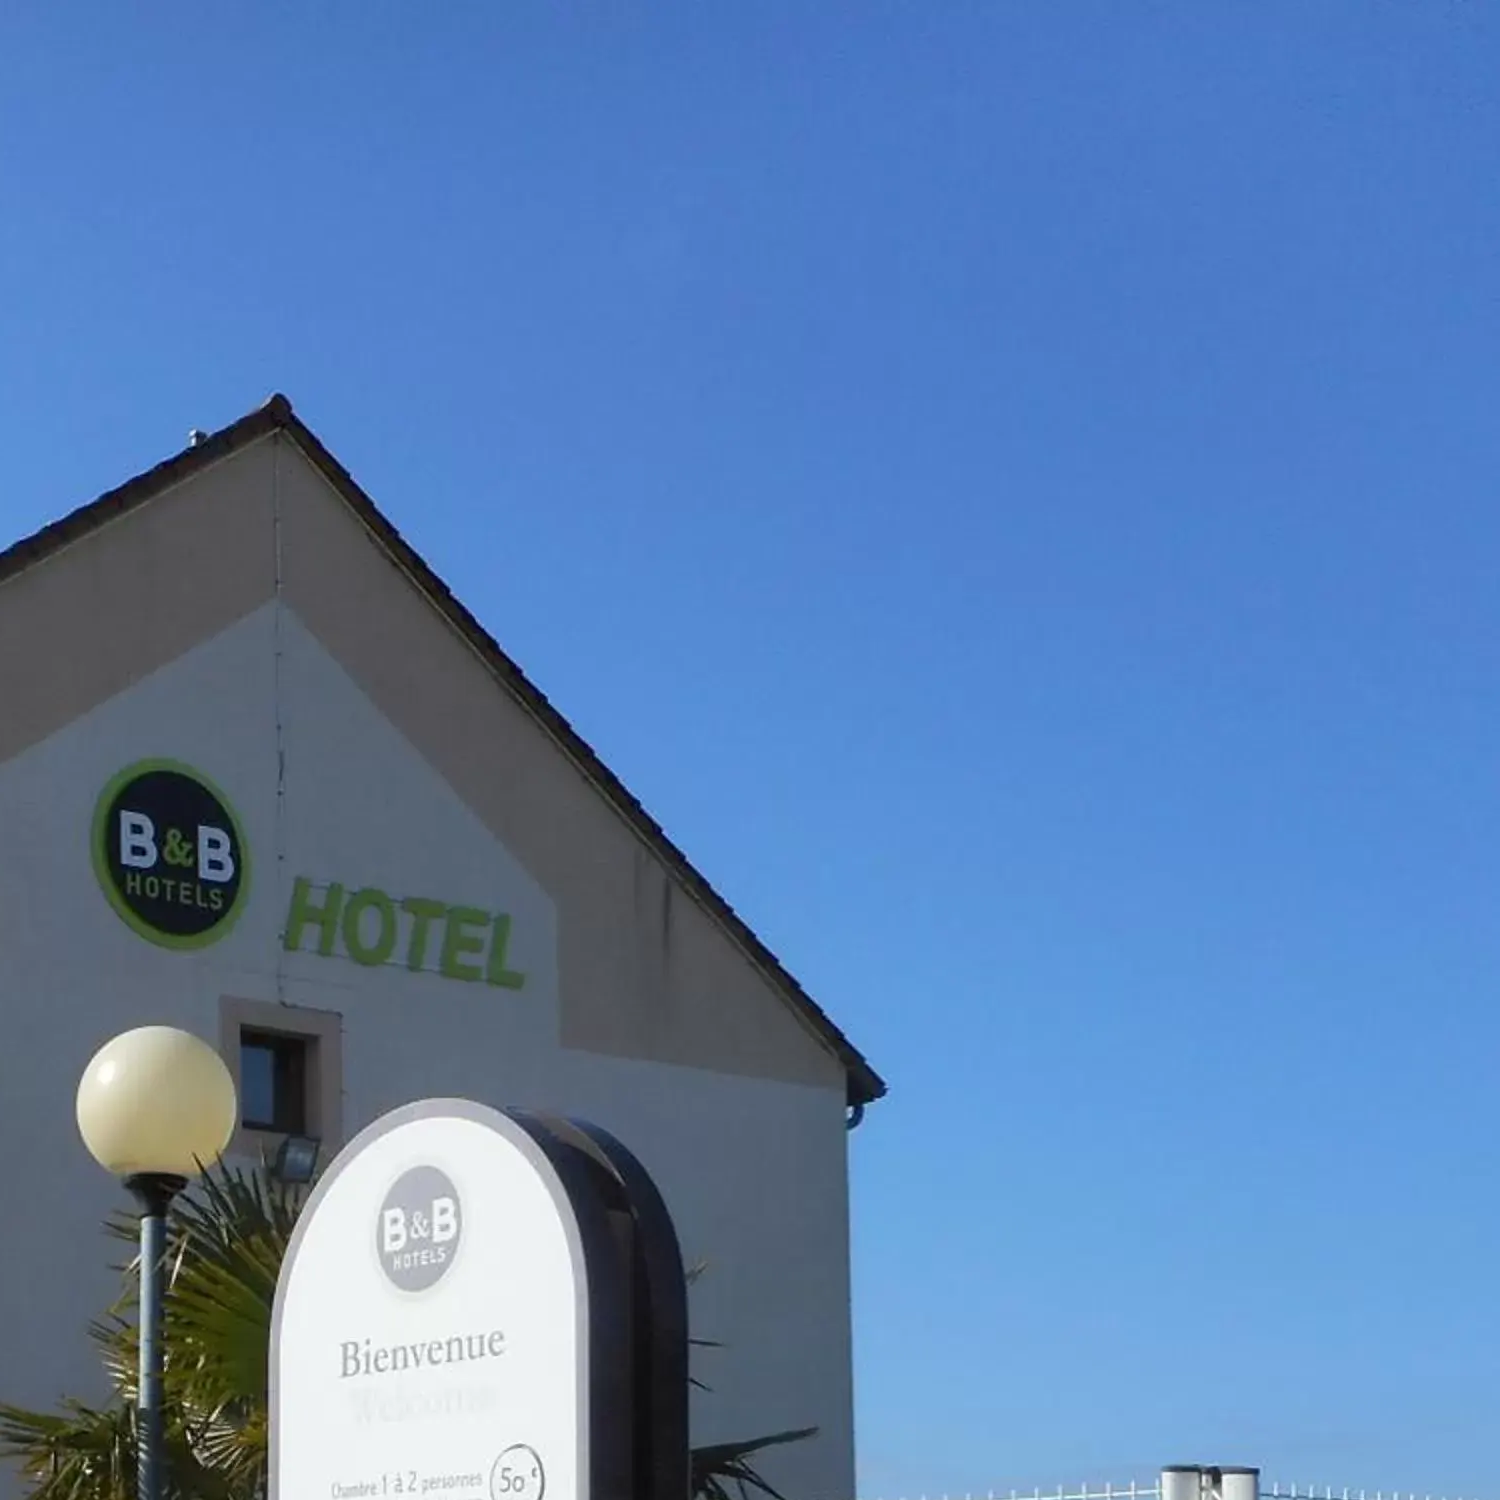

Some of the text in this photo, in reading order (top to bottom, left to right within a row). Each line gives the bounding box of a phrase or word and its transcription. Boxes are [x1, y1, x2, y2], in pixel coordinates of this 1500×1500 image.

[119, 810, 235, 883] B&B
[126, 872, 224, 911] HOTELS
[284, 876, 525, 990] HOTEL
[383, 1197, 457, 1253] B&B
[393, 1248, 447, 1271] HOTELS
[338, 1329, 507, 1379] Bienvenue
[331, 1482, 377, 1499] Chambre
[382, 1475, 388, 1495] 1
[407, 1471, 418, 1492] 2
[422, 1473, 482, 1495] personnes
